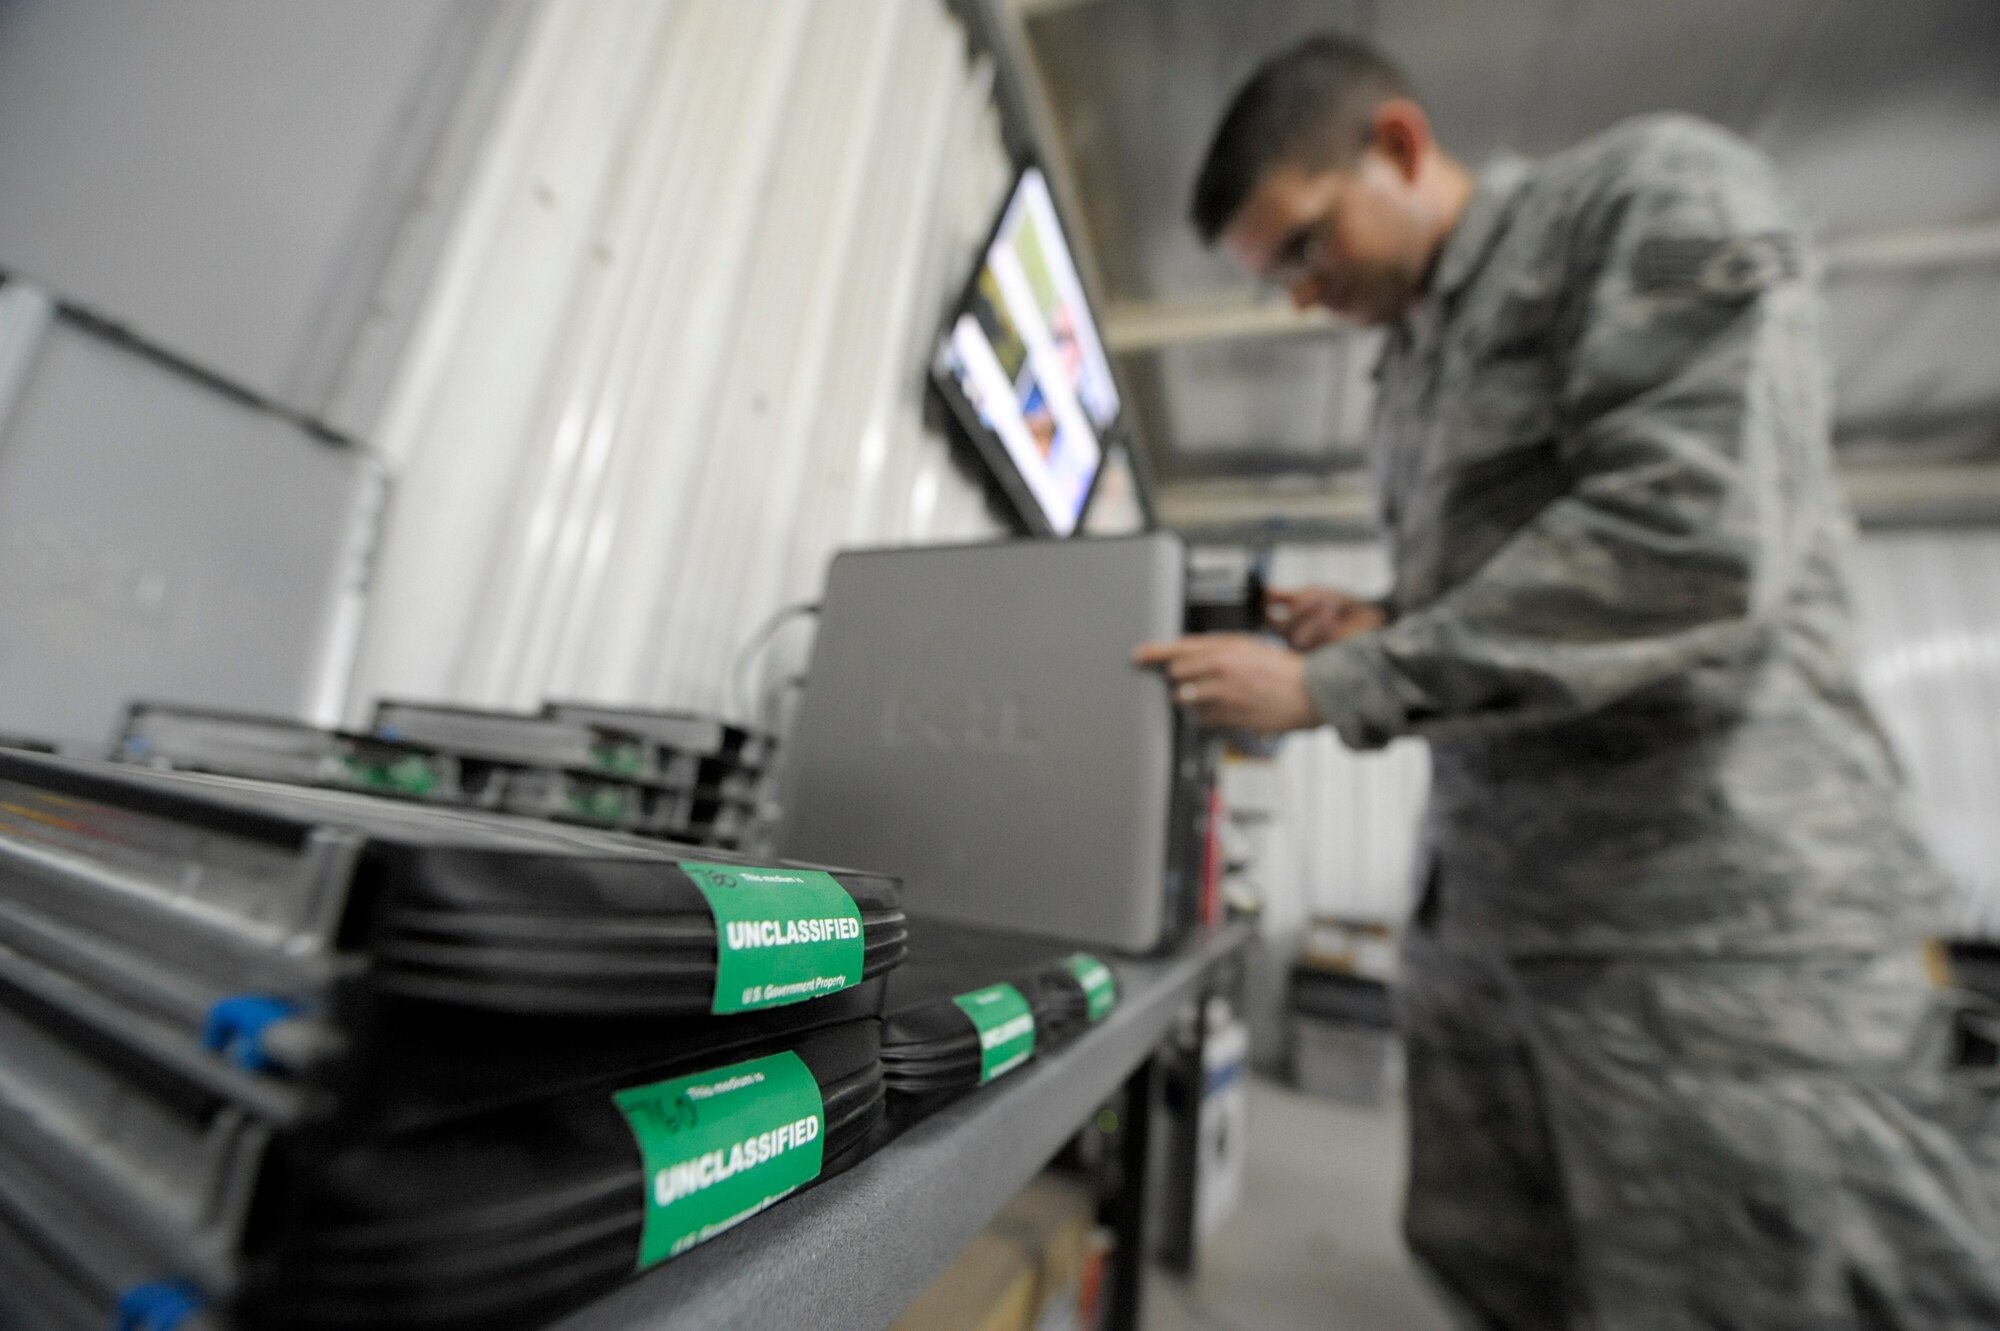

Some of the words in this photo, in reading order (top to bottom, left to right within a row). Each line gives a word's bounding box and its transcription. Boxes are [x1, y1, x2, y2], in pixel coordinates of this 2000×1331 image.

[726, 917, 860, 950] UNCLASSIFIED
[764, 981, 815, 1001] Government
[814, 974, 847, 990] Property
[654, 1114, 819, 1208] UNCLASSIFIED
